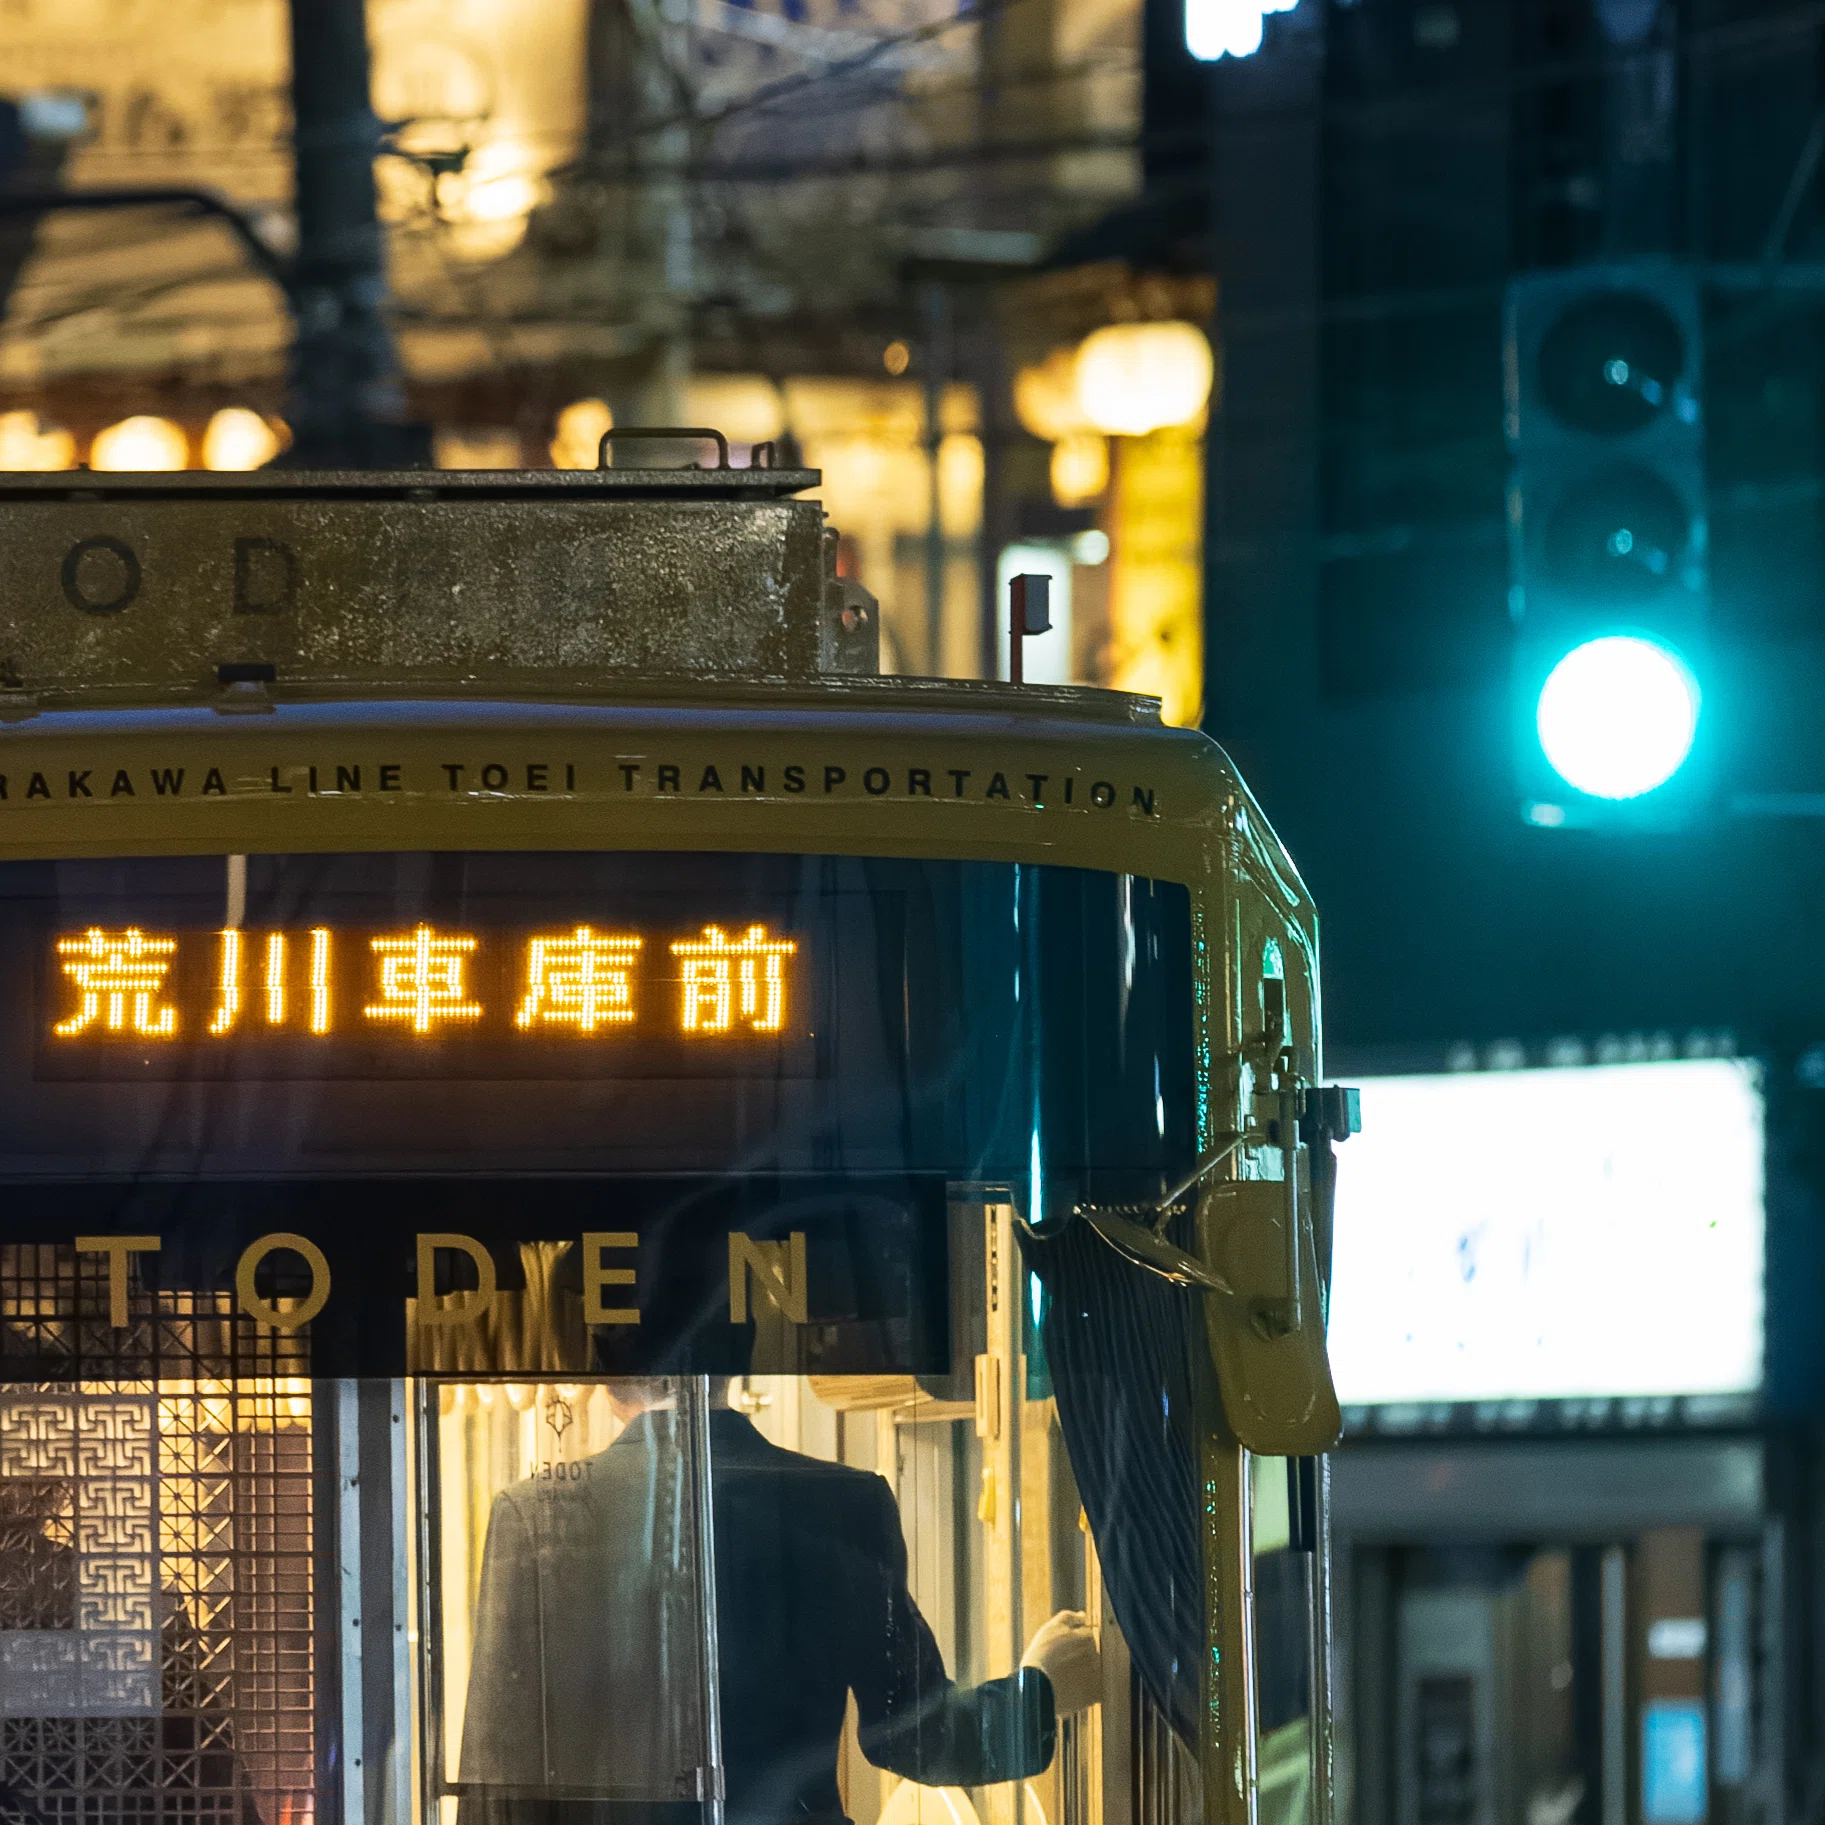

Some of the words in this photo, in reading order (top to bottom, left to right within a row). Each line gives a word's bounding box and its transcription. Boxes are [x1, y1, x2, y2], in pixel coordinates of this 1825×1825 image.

[272, 763, 404, 793] LINE
[443, 762, 576, 792] TOEI
[619, 764, 1159, 817] TRANSPORTATION
[55, 924, 796, 1035] 荒川車庫前
[76, 1232, 808, 1327] TODEN
